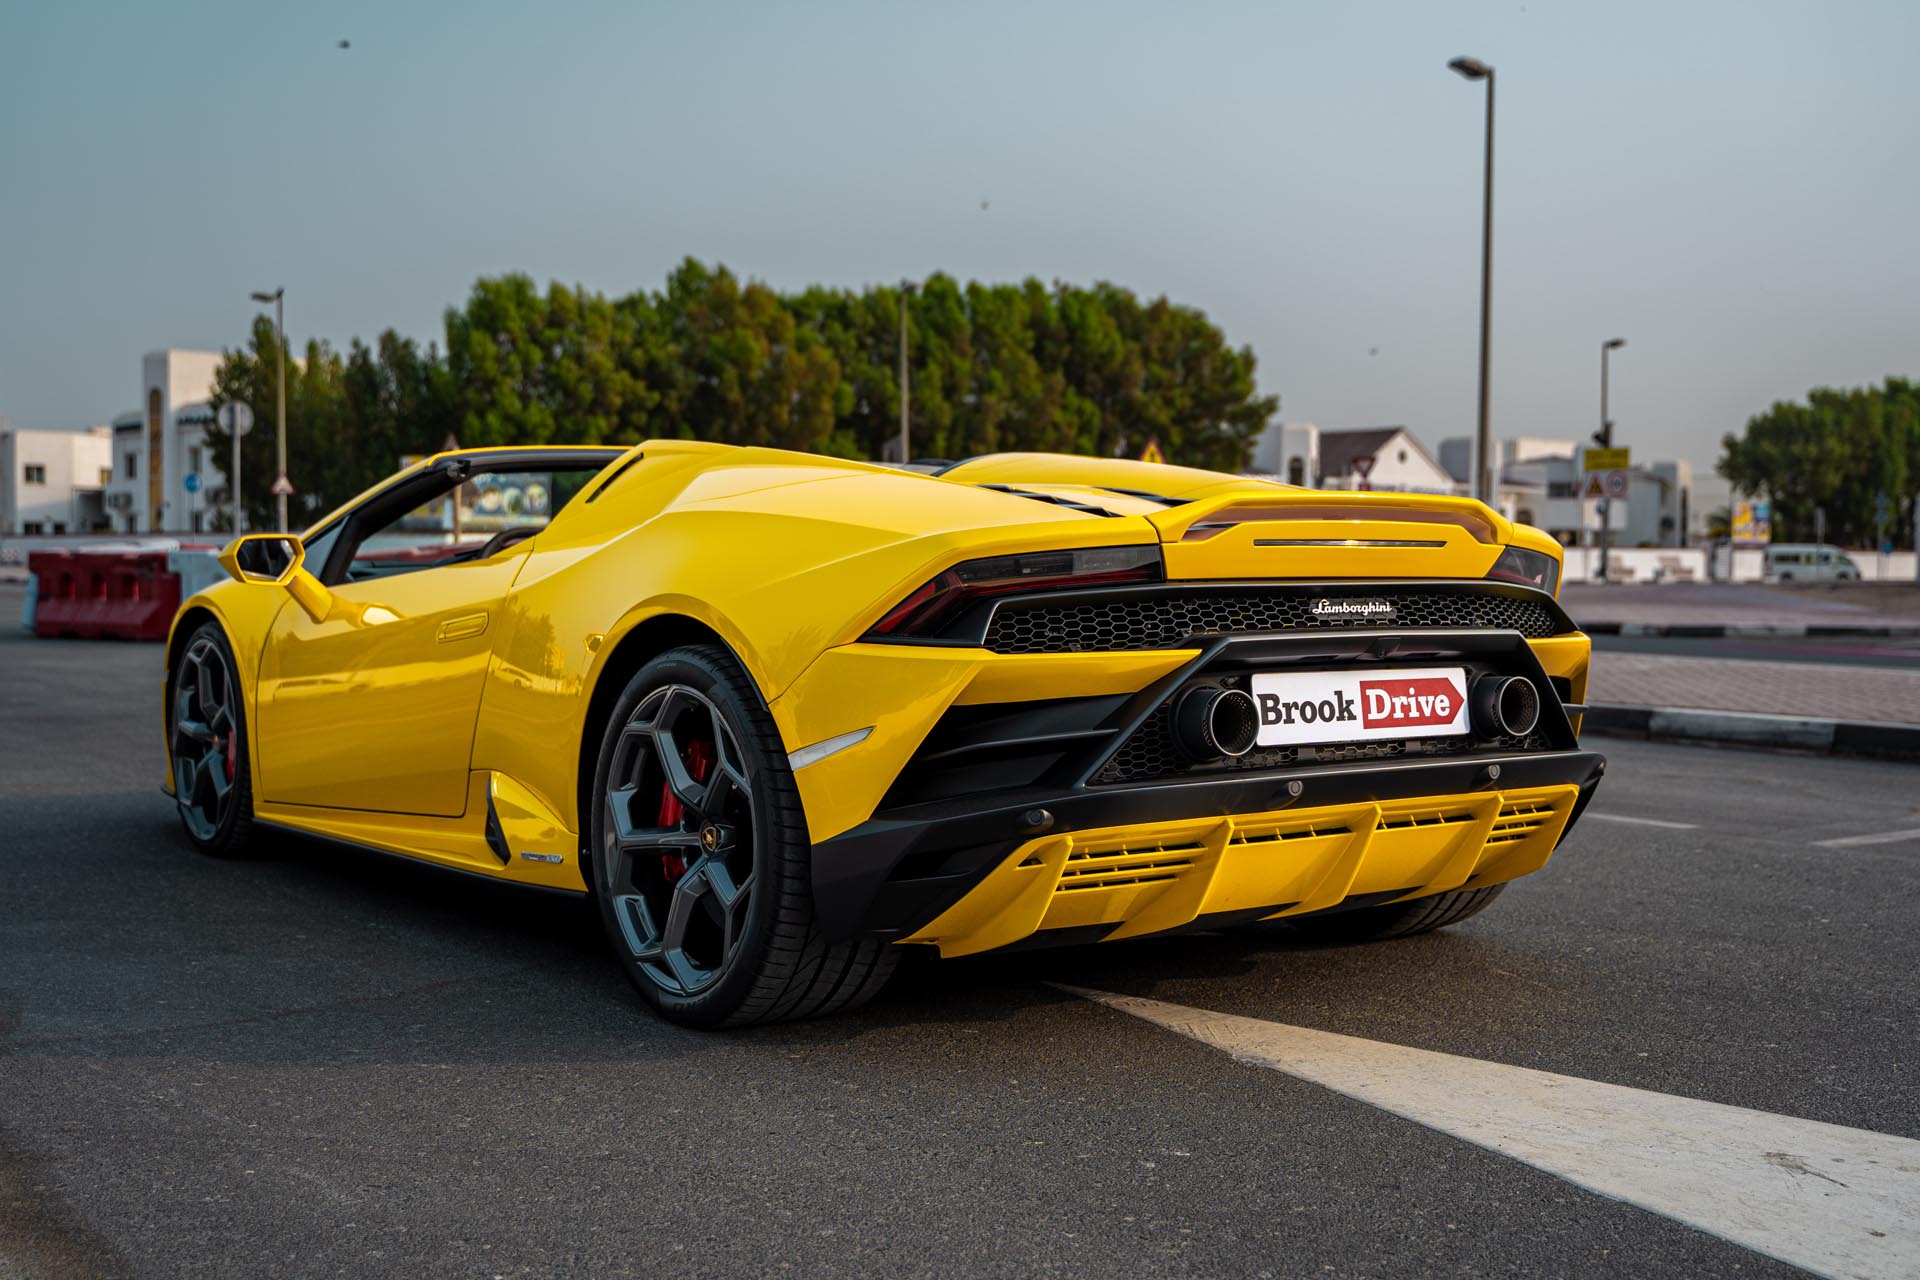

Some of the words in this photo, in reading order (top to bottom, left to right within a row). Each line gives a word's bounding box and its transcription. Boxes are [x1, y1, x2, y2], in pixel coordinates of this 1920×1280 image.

[1312, 599, 1392, 616] Lamborghini
[1256, 690, 1357, 725] Brook
[1365, 687, 1451, 720] Drive
